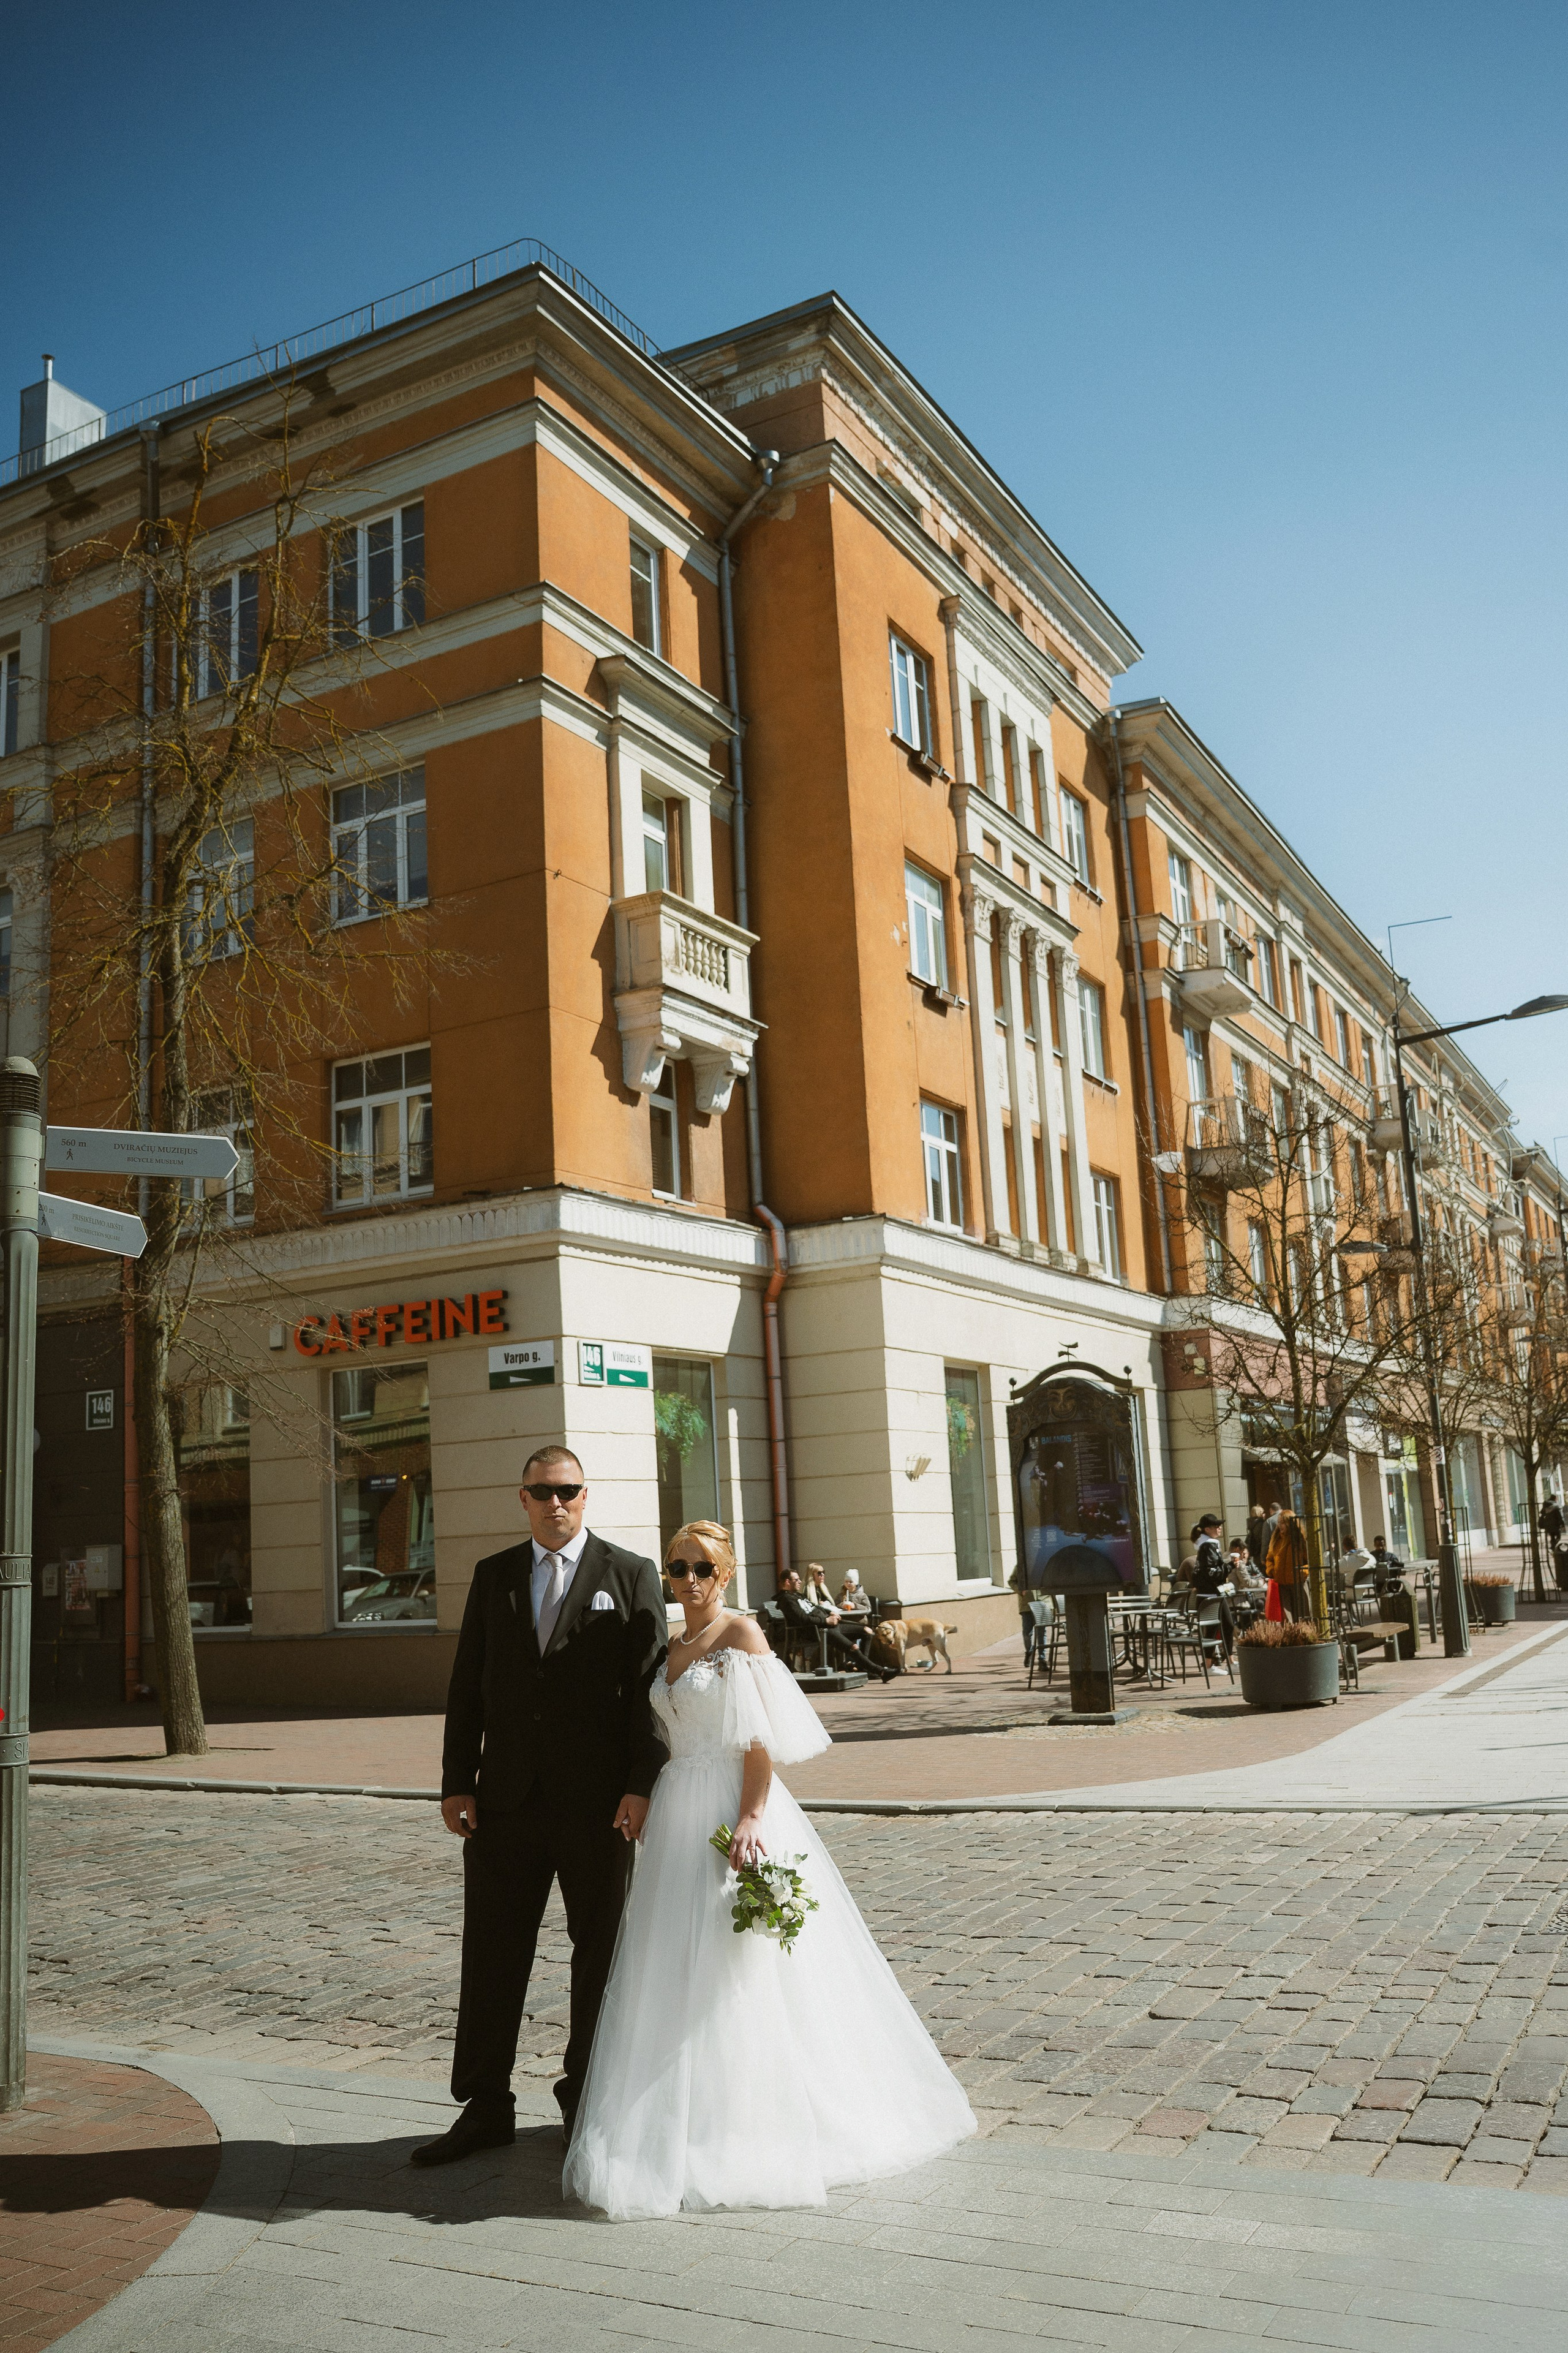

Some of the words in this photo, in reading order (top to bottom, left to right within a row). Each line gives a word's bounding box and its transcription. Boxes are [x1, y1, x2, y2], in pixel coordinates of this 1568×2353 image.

[113, 1143, 156, 1154] DVIRAČIŲ
[72, 1214, 105, 1227] PRISIKĖLIMO
[74, 1226, 104, 1238] RESURRECTION
[105, 1233, 121, 1242] SQUARE
[294, 1290, 503, 1356] CAFFEINE
[504, 1352, 530, 1364] Varpo
[532, 1351, 541, 1362] g.
[583, 1345, 601, 1366] 146
[612, 1351, 636, 1364] Vilniaus
[92, 1397, 111, 1414] 146
